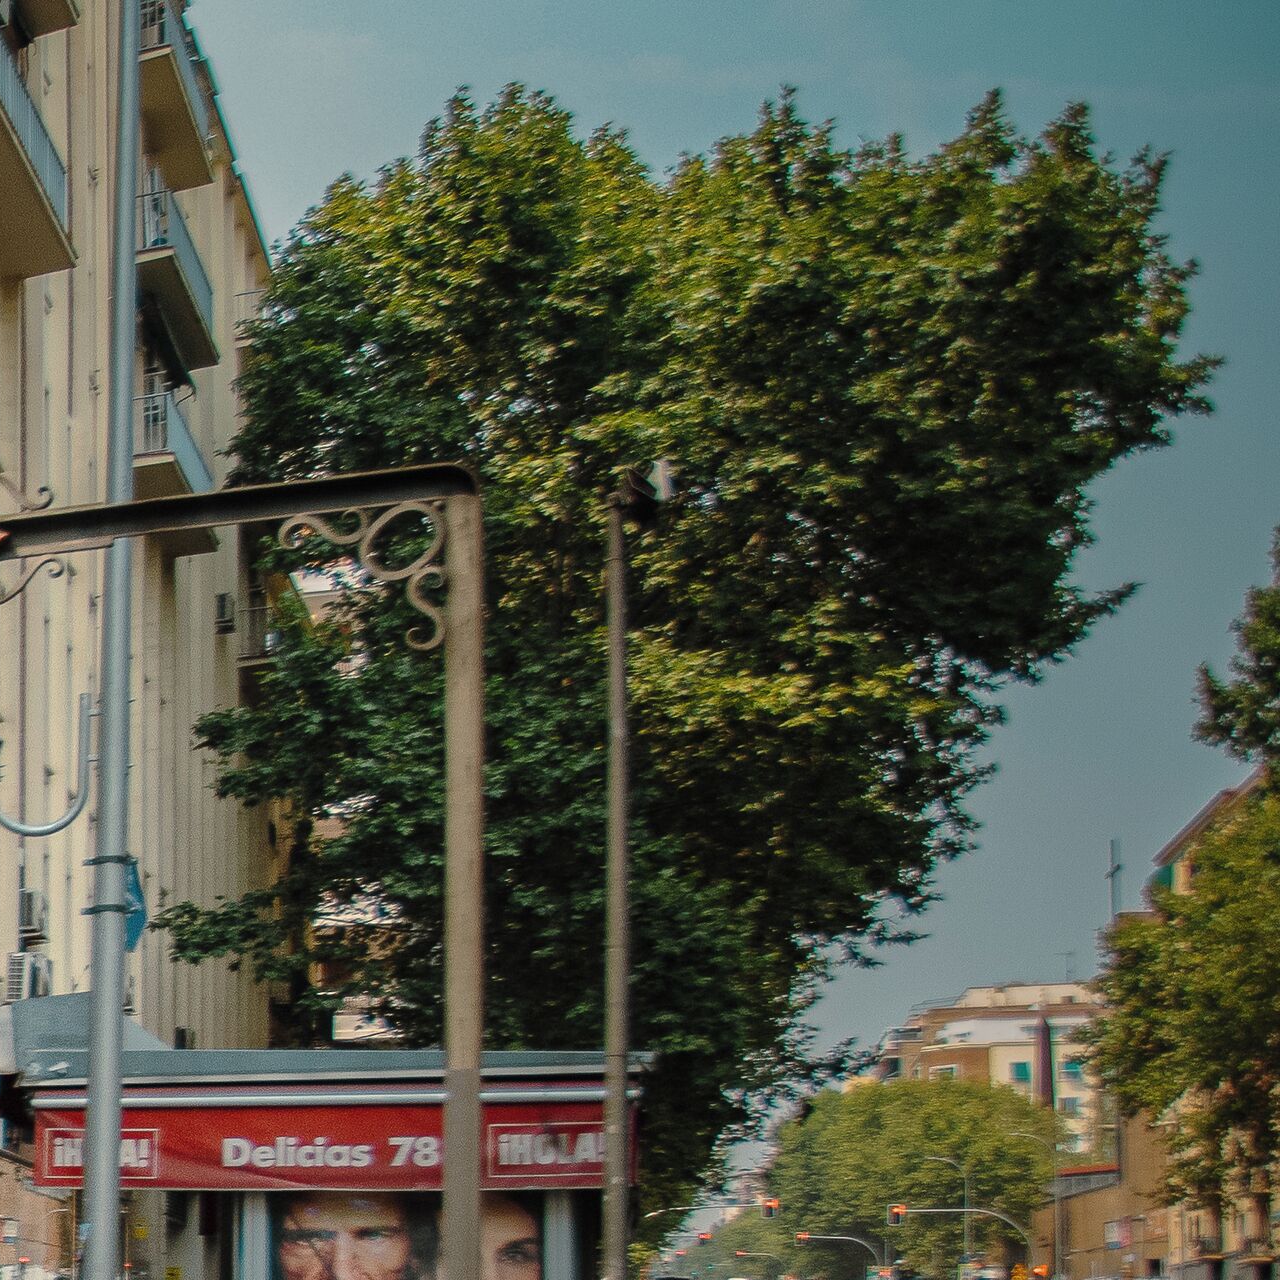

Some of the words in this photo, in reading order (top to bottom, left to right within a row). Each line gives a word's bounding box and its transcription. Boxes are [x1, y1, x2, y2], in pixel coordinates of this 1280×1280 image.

[53, 1137, 150, 1167] ¡HA!
[222, 1137, 373, 1169] Delicias
[387, 1137, 441, 1167] 78
